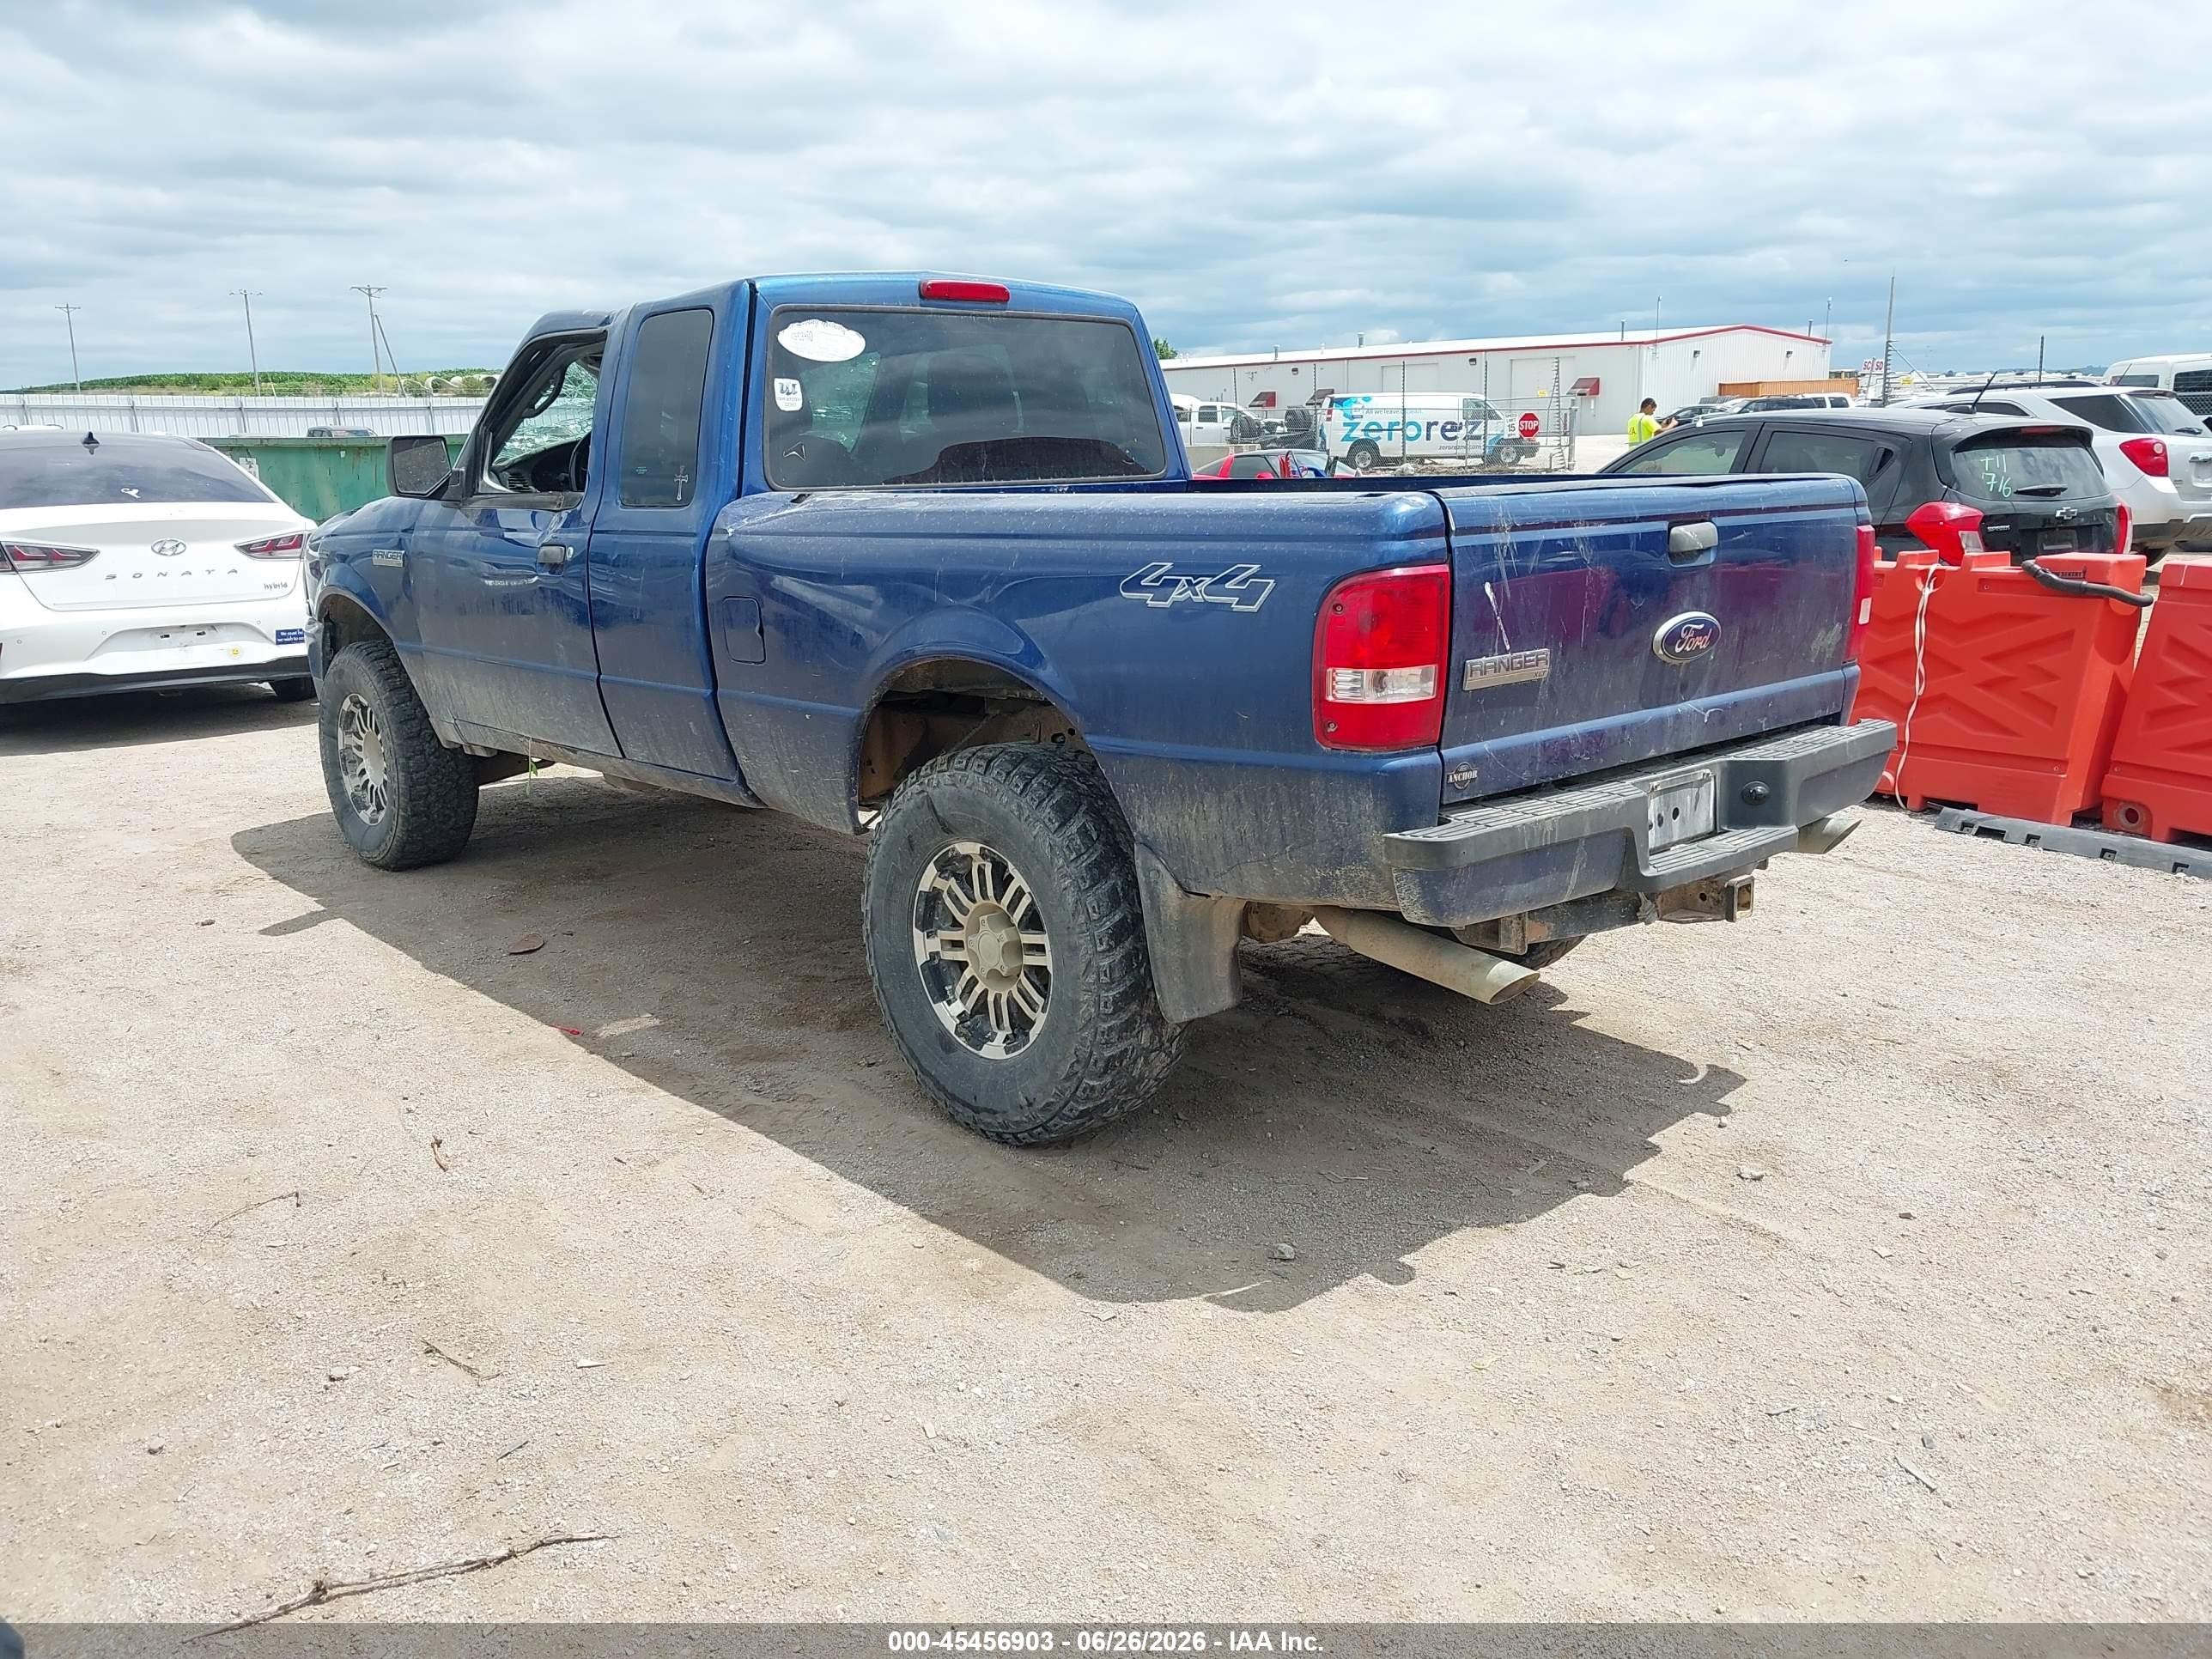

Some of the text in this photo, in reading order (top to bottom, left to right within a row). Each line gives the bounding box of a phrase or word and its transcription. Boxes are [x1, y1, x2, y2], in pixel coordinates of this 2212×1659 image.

[1340, 420, 1484, 442] zerorez
[1507, 423, 1516, 432] 15
[1519, 420, 1538, 430] STOP
[373, 550, 403, 561] RANGER
[105, 568, 239, 580] SONATA
[1119, 562, 1277, 612] 4x4
[1674, 623, 1713, 653] Ford
[1468, 653, 1549, 678] RANGER
[1447, 769, 1478, 784] ANCHOR
